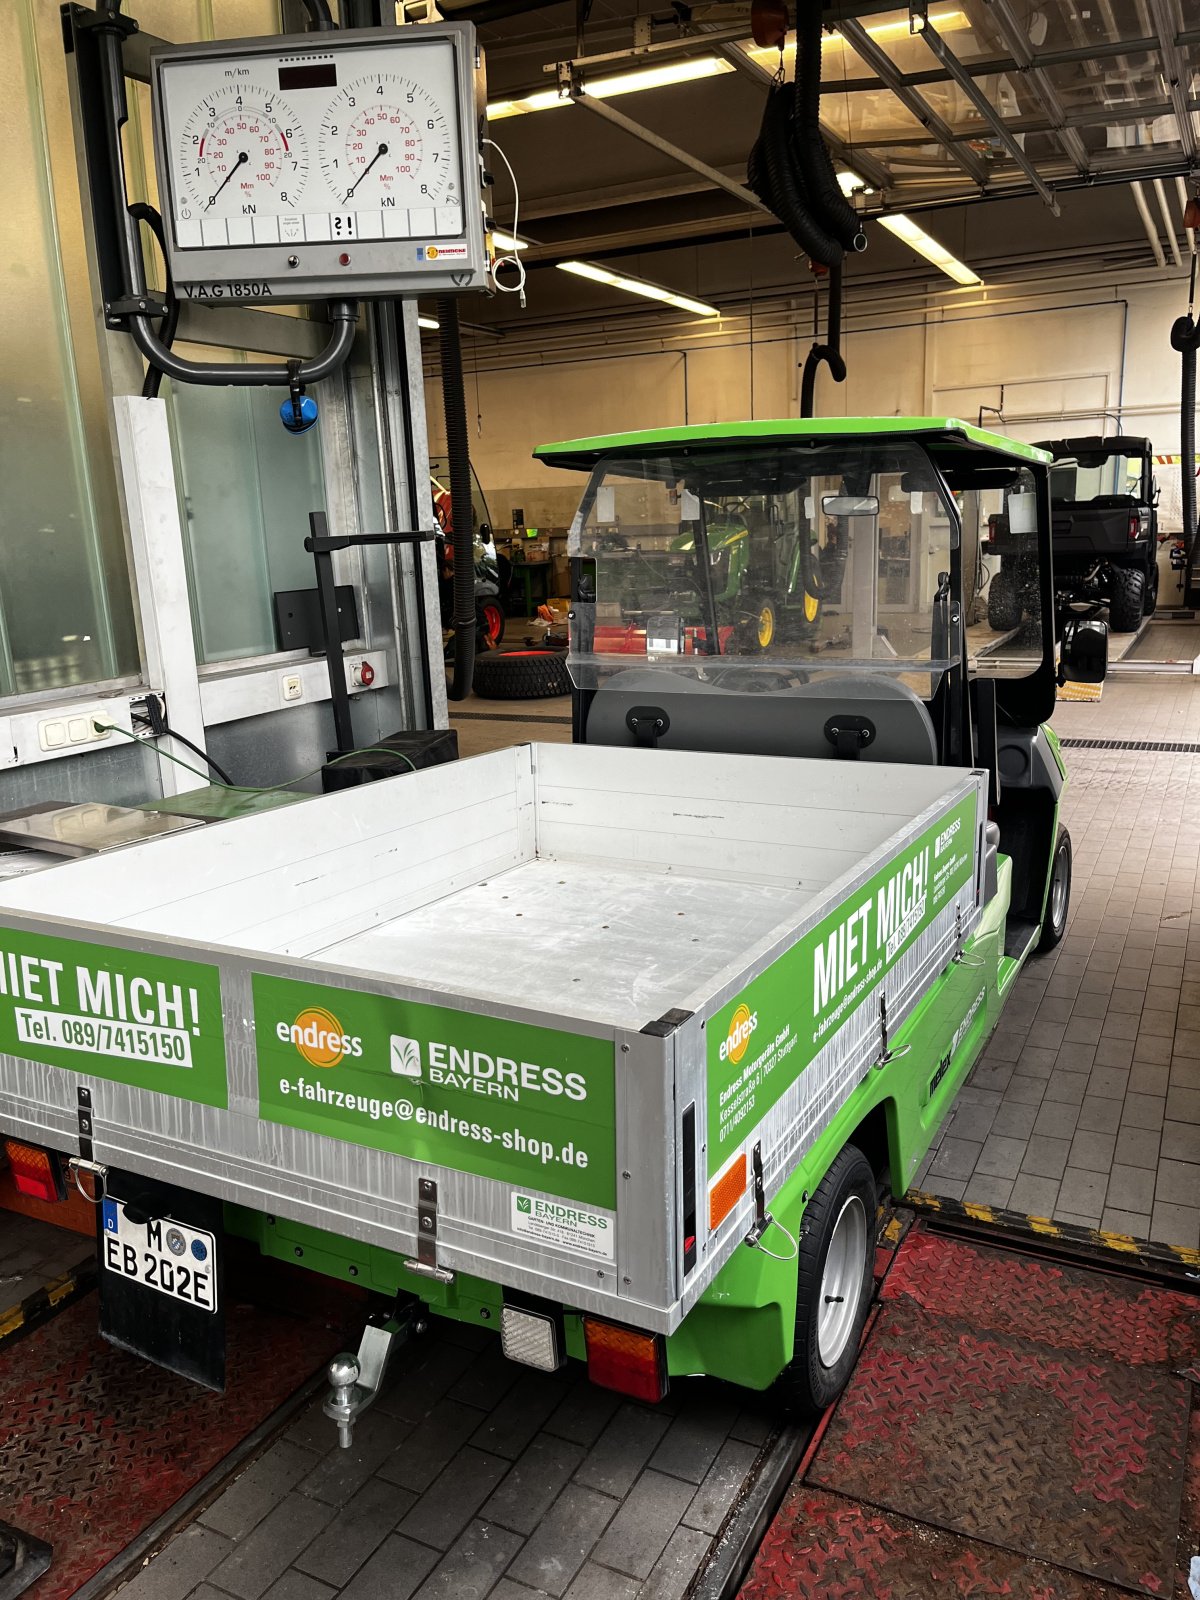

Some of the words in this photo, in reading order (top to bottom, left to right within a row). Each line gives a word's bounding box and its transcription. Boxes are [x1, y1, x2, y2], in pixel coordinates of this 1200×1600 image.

[225, 68, 249, 77] m/km
[376, 86, 384, 95] 4
[236, 96, 242, 105] 4
[349, 97, 356, 106] 3
[407, 93, 414, 102] 5
[265, 103, 272, 112] 5
[209, 108, 216, 117] 3
[427, 120, 434, 129] 6
[286, 129, 292, 138] 6
[331, 126, 338, 135] 2
[193, 136, 199, 144] 2
[432, 153, 438, 162] 7
[292, 162, 298, 171] 7
[333, 159, 338, 168] 1
[195, 168, 200, 176] 1
[421, 184, 427, 193] 8
[281, 192, 287, 201] 8
[381, 197, 395, 207] kN
[242, 205, 256, 214] kN
[184, 284, 223, 298] V.A.G
[227, 283, 272, 296] 1850A
[814, 897, 872, 1017] MIET
[877, 846, 929, 950] MICH!
[0, 952, 63, 1006] IET
[76, 965, 200, 1037] MICH!
[20, 1012, 56, 1041] Tel.
[62, 1019, 185, 1061] 089/7415150
[276, 1021, 363, 1057] endress
[719, 1011, 758, 1061] endress
[720, 1076, 742, 1106] Endress
[776, 1024, 790, 1048] GmbH
[429, 1042, 587, 1101] ENDRESS
[930, 1049, 952, 1098] melex
[430, 1068, 519, 1102] BAYERN
[279, 1077, 588, 1168] e-fahrzeuge@endress-shop.de
[535, 1200, 607, 1229] ENDRESS
[536, 1211, 577, 1227] BAYERN
[108, 1219, 113, 1228] D
[147, 1220, 162, 1252] M
[108, 1238, 138, 1276] EB
[144, 1253, 210, 1307] 202E
